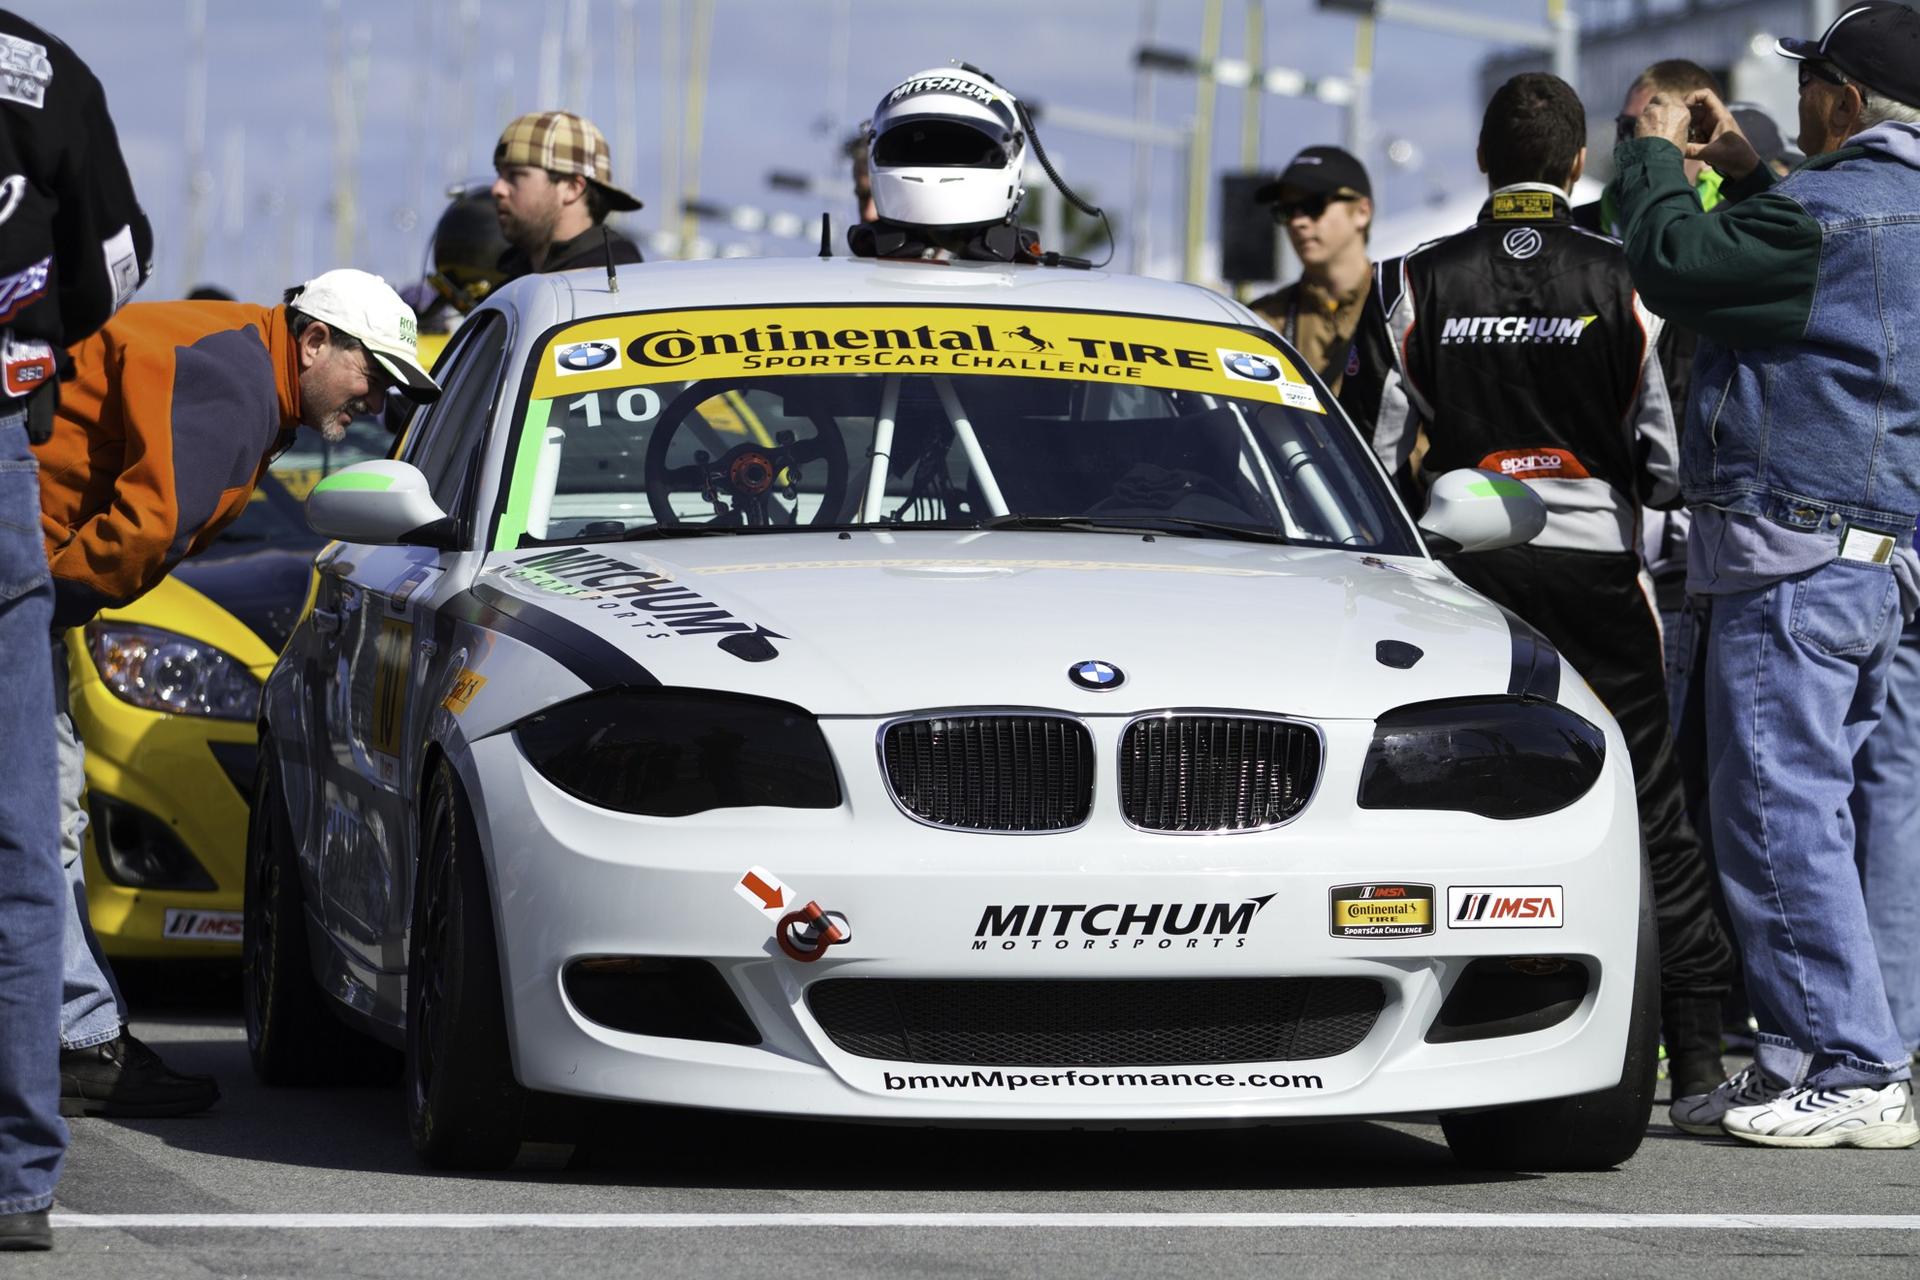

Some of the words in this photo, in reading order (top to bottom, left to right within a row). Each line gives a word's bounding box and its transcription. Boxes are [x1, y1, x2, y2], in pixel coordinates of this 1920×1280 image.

[888, 77, 993, 105] MITCHUM
[1441, 317, 1585, 338] MITCHUM
[626, 324, 1000, 367] Continental
[1067, 337, 1214, 372] TIRE
[1440, 336, 1579, 345] MOTORSPORTS
[952, 353, 1142, 379] CHALLENGE
[569, 388, 661, 427] 10
[1501, 456, 1562, 474] sparco
[513, 547, 757, 636] MITCHUM
[1374, 887, 1406, 897] IMSA
[1348, 902, 1409, 918] Continental
[1490, 897, 1556, 919] IMSA
[974, 903, 1256, 937] MITCHUM
[971, 938, 1246, 950] MOTORSPORTS
[883, 1071, 1324, 1091] bmwMperformance.com
